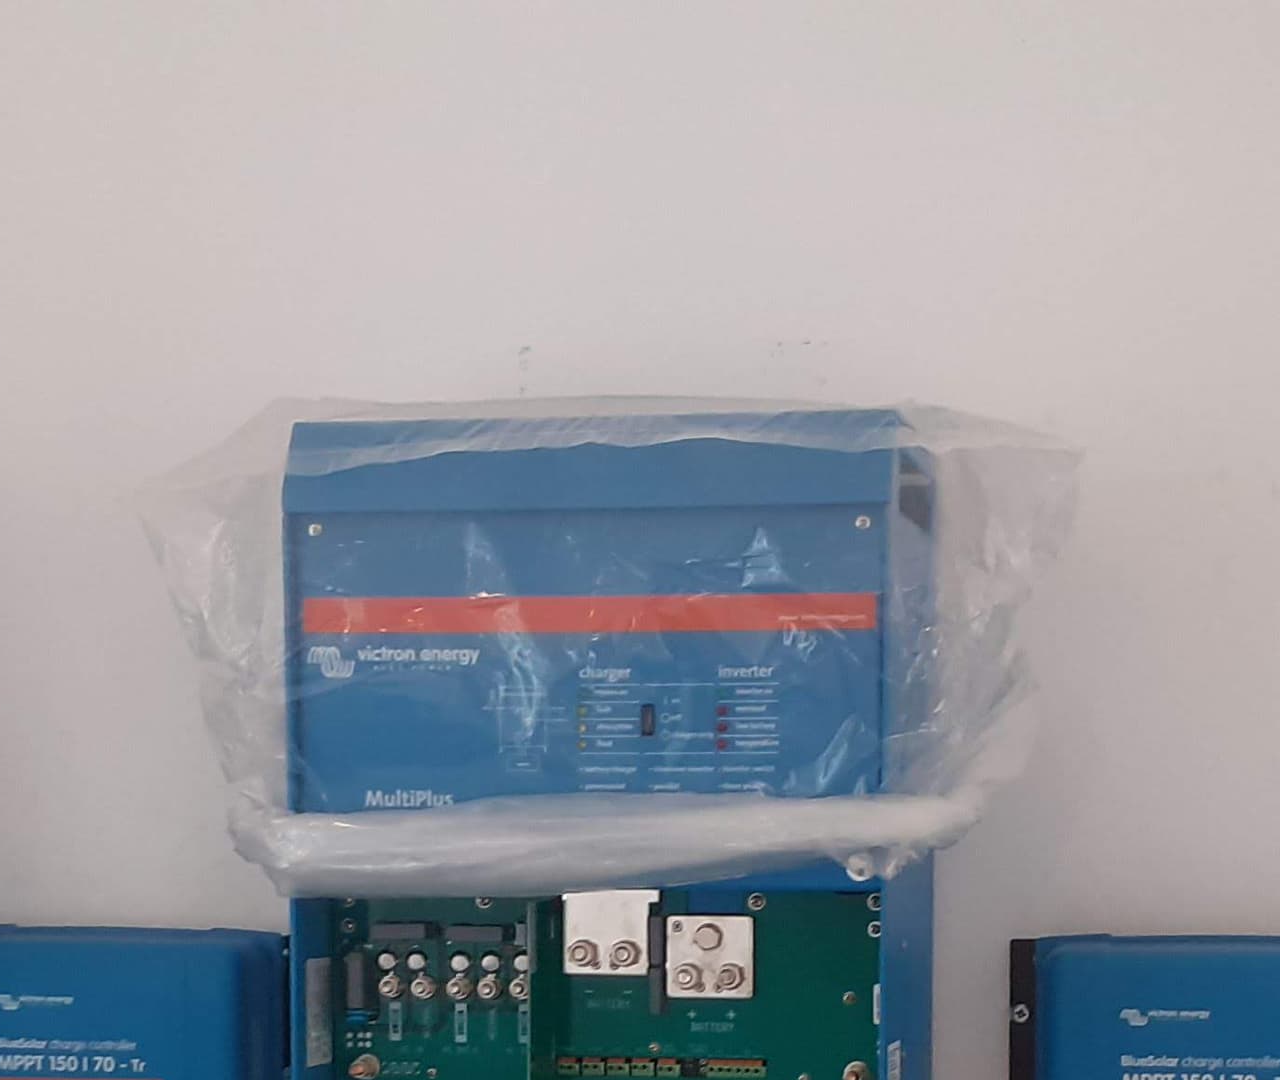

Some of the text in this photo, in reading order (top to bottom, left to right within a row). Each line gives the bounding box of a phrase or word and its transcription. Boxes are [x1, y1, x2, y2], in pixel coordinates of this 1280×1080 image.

[358, 644, 480, 666] victron energy
[578, 665, 632, 682] charger
[718, 664, 775, 678] inverter
[365, 788, 455, 807] MultiPlus
[49, 1054, 79, 1072] 150
[93, 1055, 116, 1073] 70
[131, 1058, 147, 1073] Tr
[1120, 1055, 1180, 1067] BlueSolar
[1181, 1056, 1224, 1071] charge
